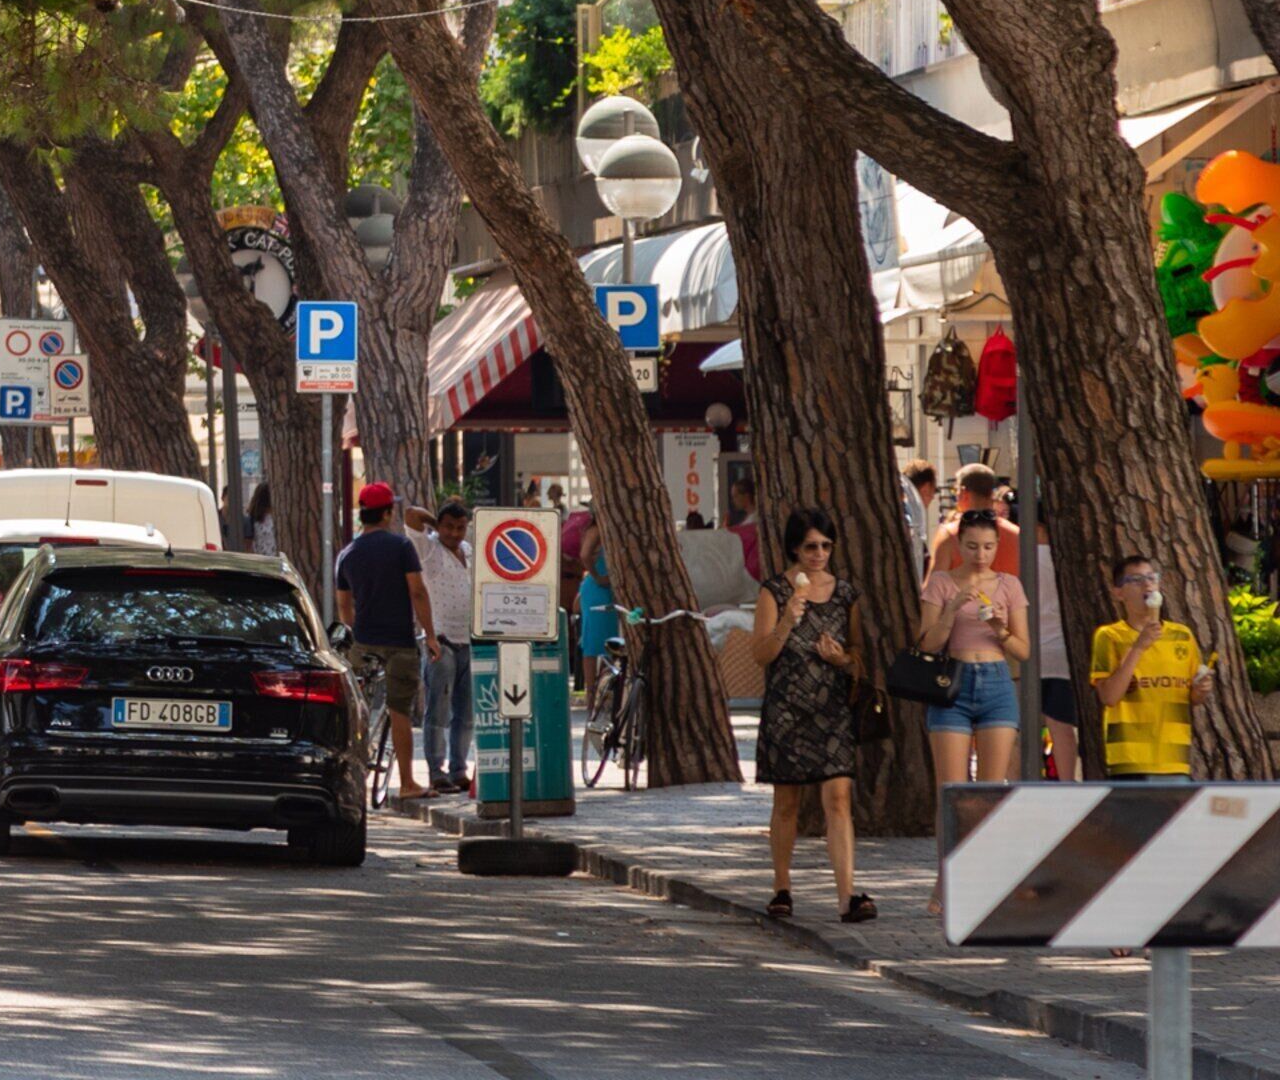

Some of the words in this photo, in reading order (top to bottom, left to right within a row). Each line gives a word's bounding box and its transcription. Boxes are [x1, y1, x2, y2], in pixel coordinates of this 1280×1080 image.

[607, 291, 647, 332] P
[309, 309, 344, 354] P
[6, 390, 24, 414] P
[127, 702, 151, 721] FD
[157, 703, 217, 723] 408GB
